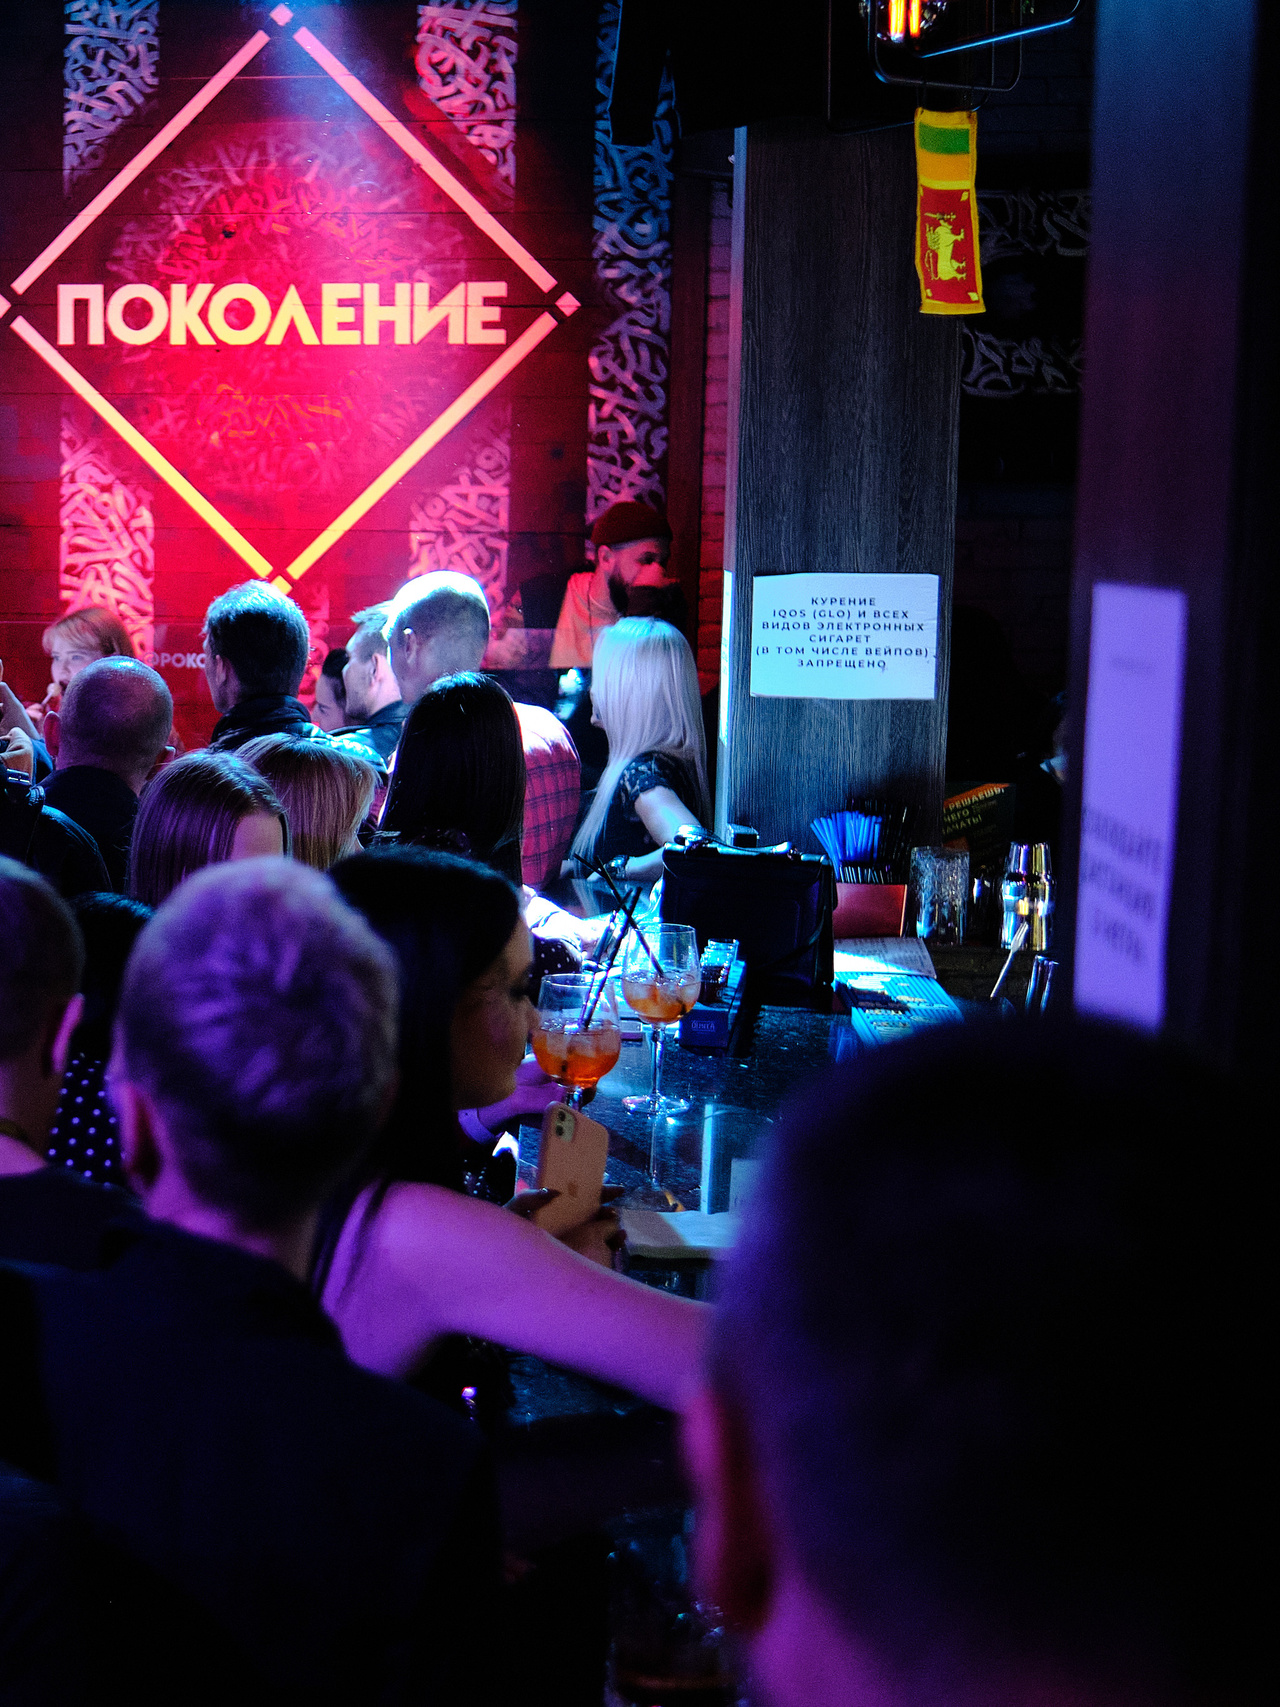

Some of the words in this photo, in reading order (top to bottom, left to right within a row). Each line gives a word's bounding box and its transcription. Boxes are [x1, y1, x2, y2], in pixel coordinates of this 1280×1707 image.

[57, 281, 508, 345] ПОКОЛЕНИЕ
[811, 597, 877, 606] КУРЕНИЕ
[773, 609, 806, 619] IQOS
[813, 609, 851, 620] (GLO)
[858, 610, 866, 619] И
[873, 610, 909, 619] ВСЕХ
[762, 621, 811, 631] ВИДОВ
[816, 622, 924, 632] ЭЛЕКТРОННЫХ
[809, 634, 871, 643] СИГАРЕТ
[756, 646, 769, 656] (В
[777, 647, 805, 655] ТОМ
[812, 647, 858, 656] ЧИСЛЕ
[865, 645, 928, 657] ВЕЙПОВ)
[797, 659, 887, 669] ЗАПРЕЩЕНО
